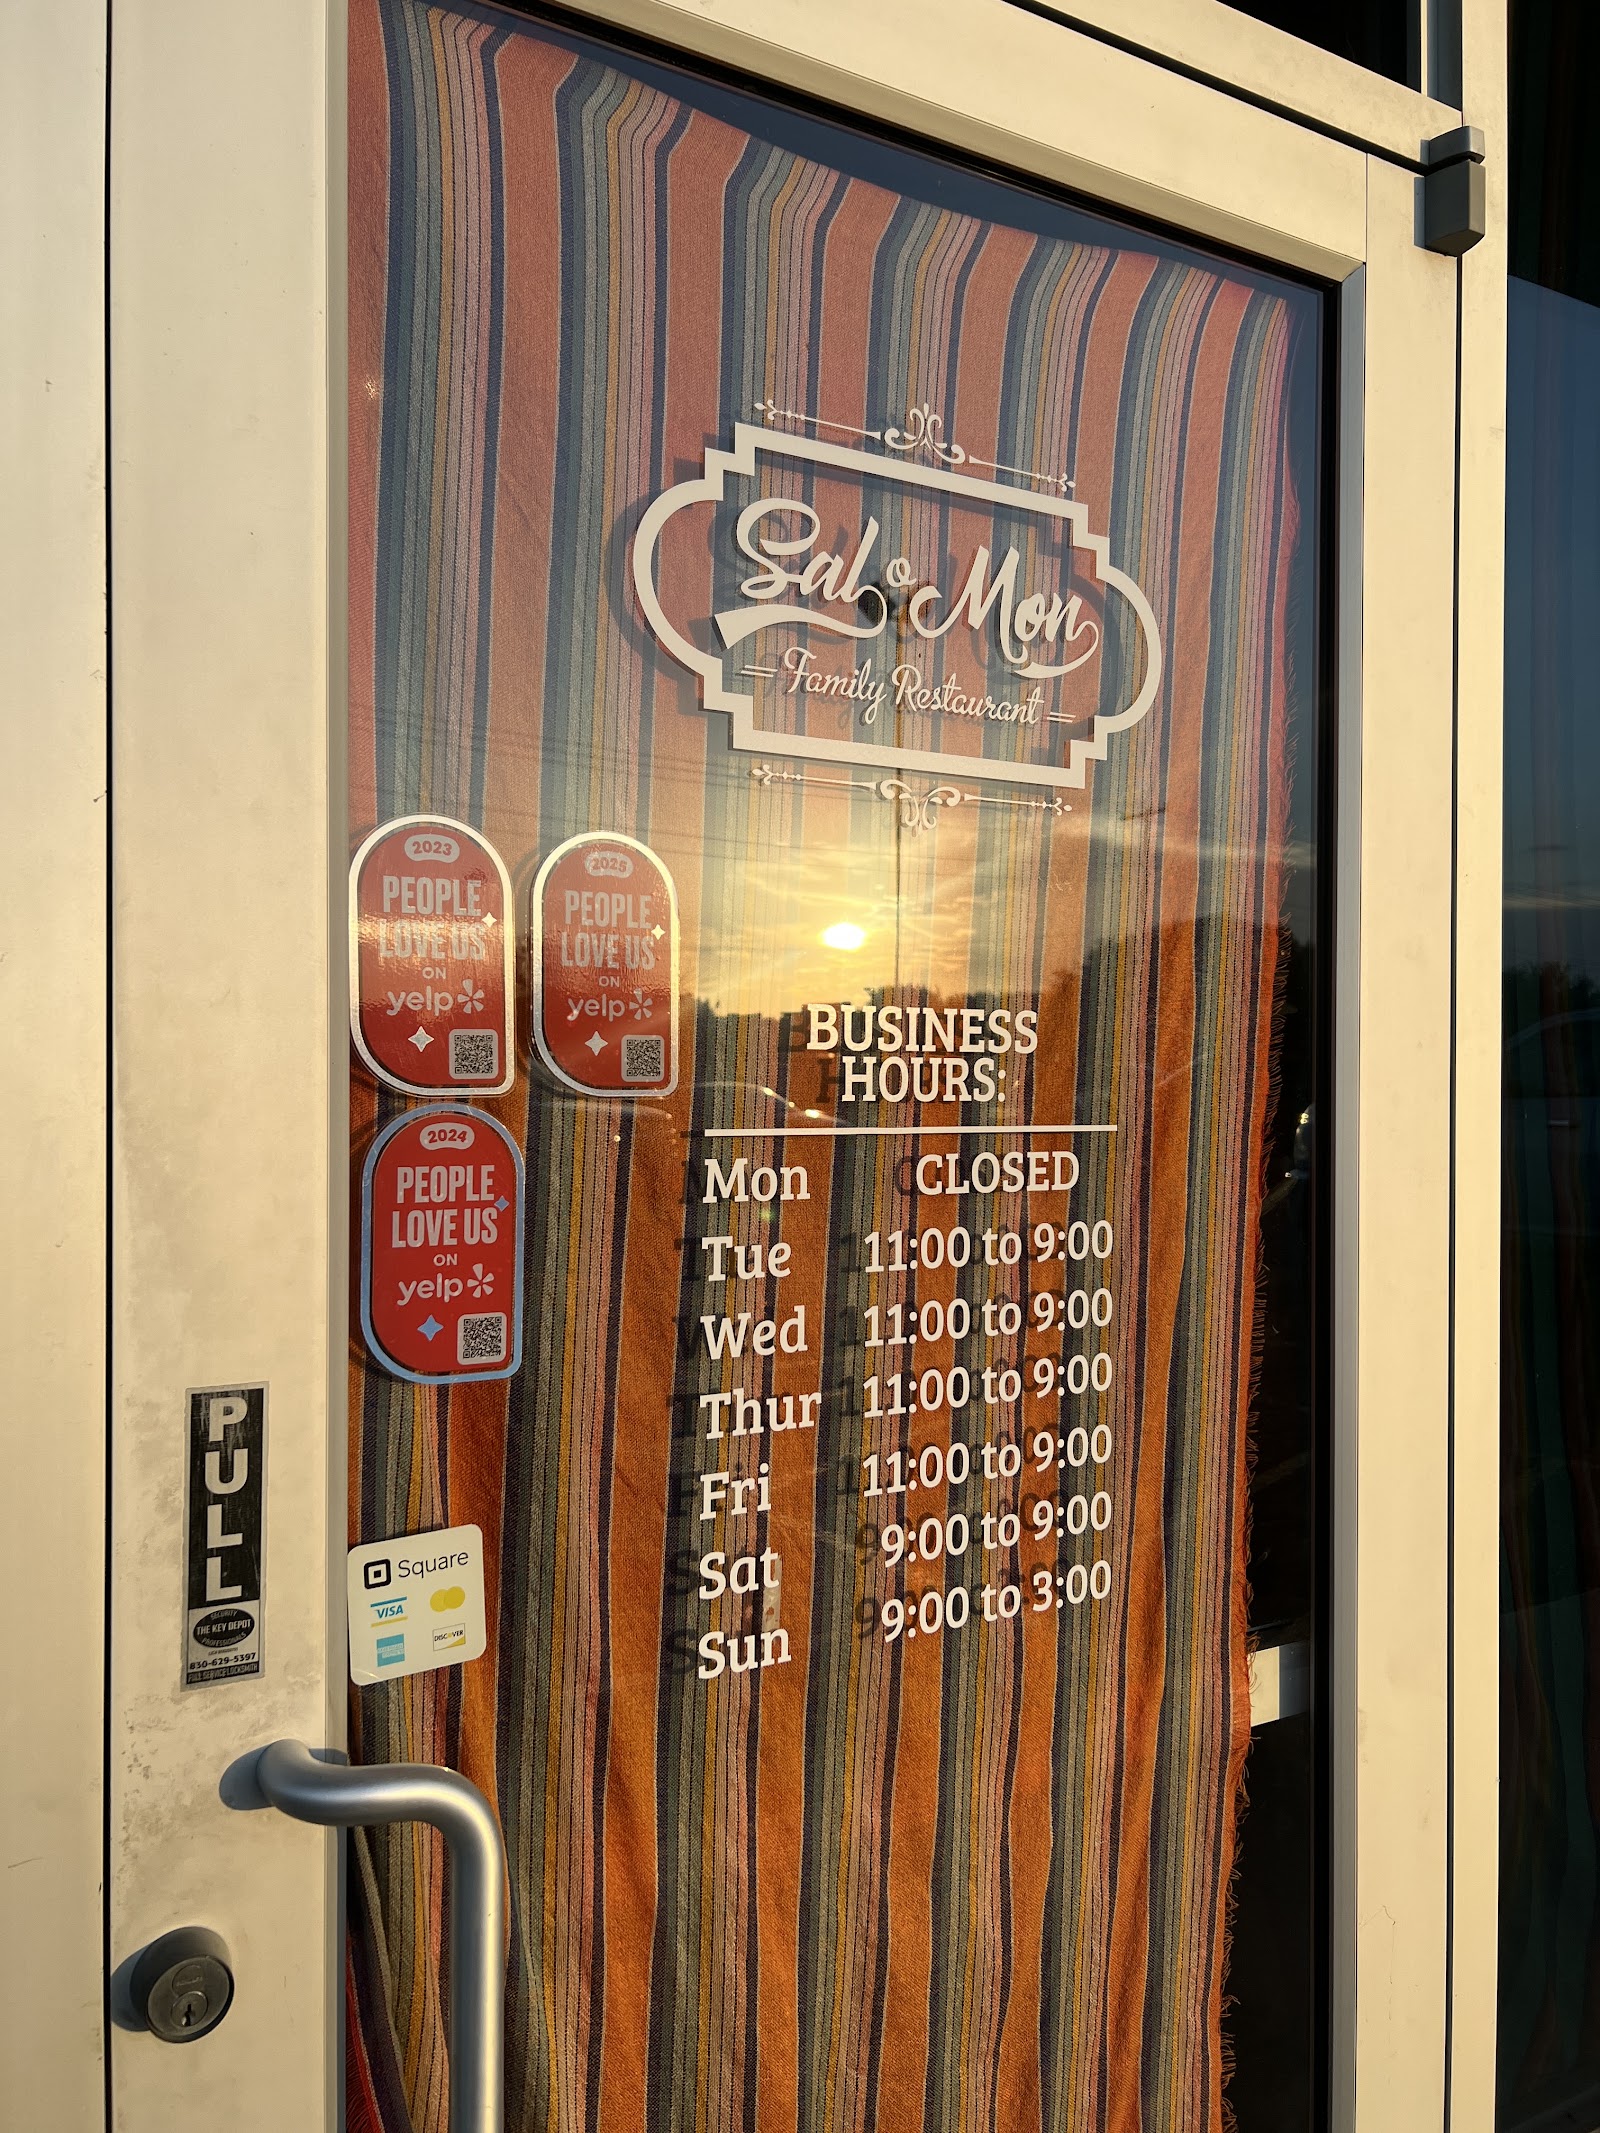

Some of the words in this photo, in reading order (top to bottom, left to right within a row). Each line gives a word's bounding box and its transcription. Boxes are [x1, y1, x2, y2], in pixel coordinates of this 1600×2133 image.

[715, 498, 887, 648] Sal
[910, 545, 1098, 679] Mon
[785, 647, 886, 725] Family
[892, 664, 1044, 725] Restaurant
[412, 840, 452, 856] 2023
[590, 855, 627, 872] 2025
[383, 875, 481, 917] PEOPLE
[565, 890, 651, 929] PEOPLE
[378, 919, 446, 959] LOVE
[451, 922, 486, 960] US
[561, 931, 622, 970] LOVE
[626, 935, 655, 970] US
[422, 966, 446, 980] ON
[598, 976, 620, 988] ON
[386, 985, 454, 1016] yelp
[567, 994, 625, 1022] yelp
[806, 1003, 1038, 1054] BUSINESS
[841, 1056, 1006, 1103] HOURS:
[427, 1129, 467, 1144] 2024
[397, 1164, 495, 1204] PEOPLE
[702, 1158, 811, 1204] Mon
[916, 1151, 1080, 1196] CLOSED
[392, 1208, 457, 1248] LOVE
[464, 1207, 498, 1245] US
[433, 1253, 458, 1267] ON
[701, 1236, 792, 1282] Tue
[864, 1226, 971, 1273] 11:00
[982, 1228, 1022, 1267] to
[1033, 1220, 1114, 1264] 9:00
[396, 1273, 463, 1306] yelp
[700, 1306, 808, 1360] Wed
[863, 1298, 971, 1348] 11:00
[982, 1297, 1022, 1336] to
[1033, 1288, 1114, 1333] 9:00
[699, 1387, 822, 1440] Thur
[862, 1366, 970, 1418] 11:00
[981, 1366, 1022, 1406] to
[1033, 1352, 1113, 1399] 9:00
[699, 1463, 772, 1521] Fri
[862, 1442, 970, 1498] 11:00
[981, 1442, 1021, 1481] to
[1033, 1424, 1113, 1473] 9:00
[205, 1396, 248, 1602] PULL
[398, 1551, 469, 1579] Square
[699, 1546, 780, 1600] Sat
[881, 1513, 970, 1568] 9:00
[980, 1510, 1021, 1550] to
[1032, 1491, 1112, 1541] 9:00
[197, 1624, 210, 1635] THE
[212, 1622, 227, 1633] KEY
[228, 1619, 251, 1630] DEPOT
[375, 1604, 404, 1619] VISA
[698, 1626, 792, 1680] Sun
[881, 1586, 970, 1643] 9:00
[980, 1583, 1021, 1623] to
[1032, 1560, 1112, 1613] 3:00
[189, 1652, 256, 1669] 830-629-5397
